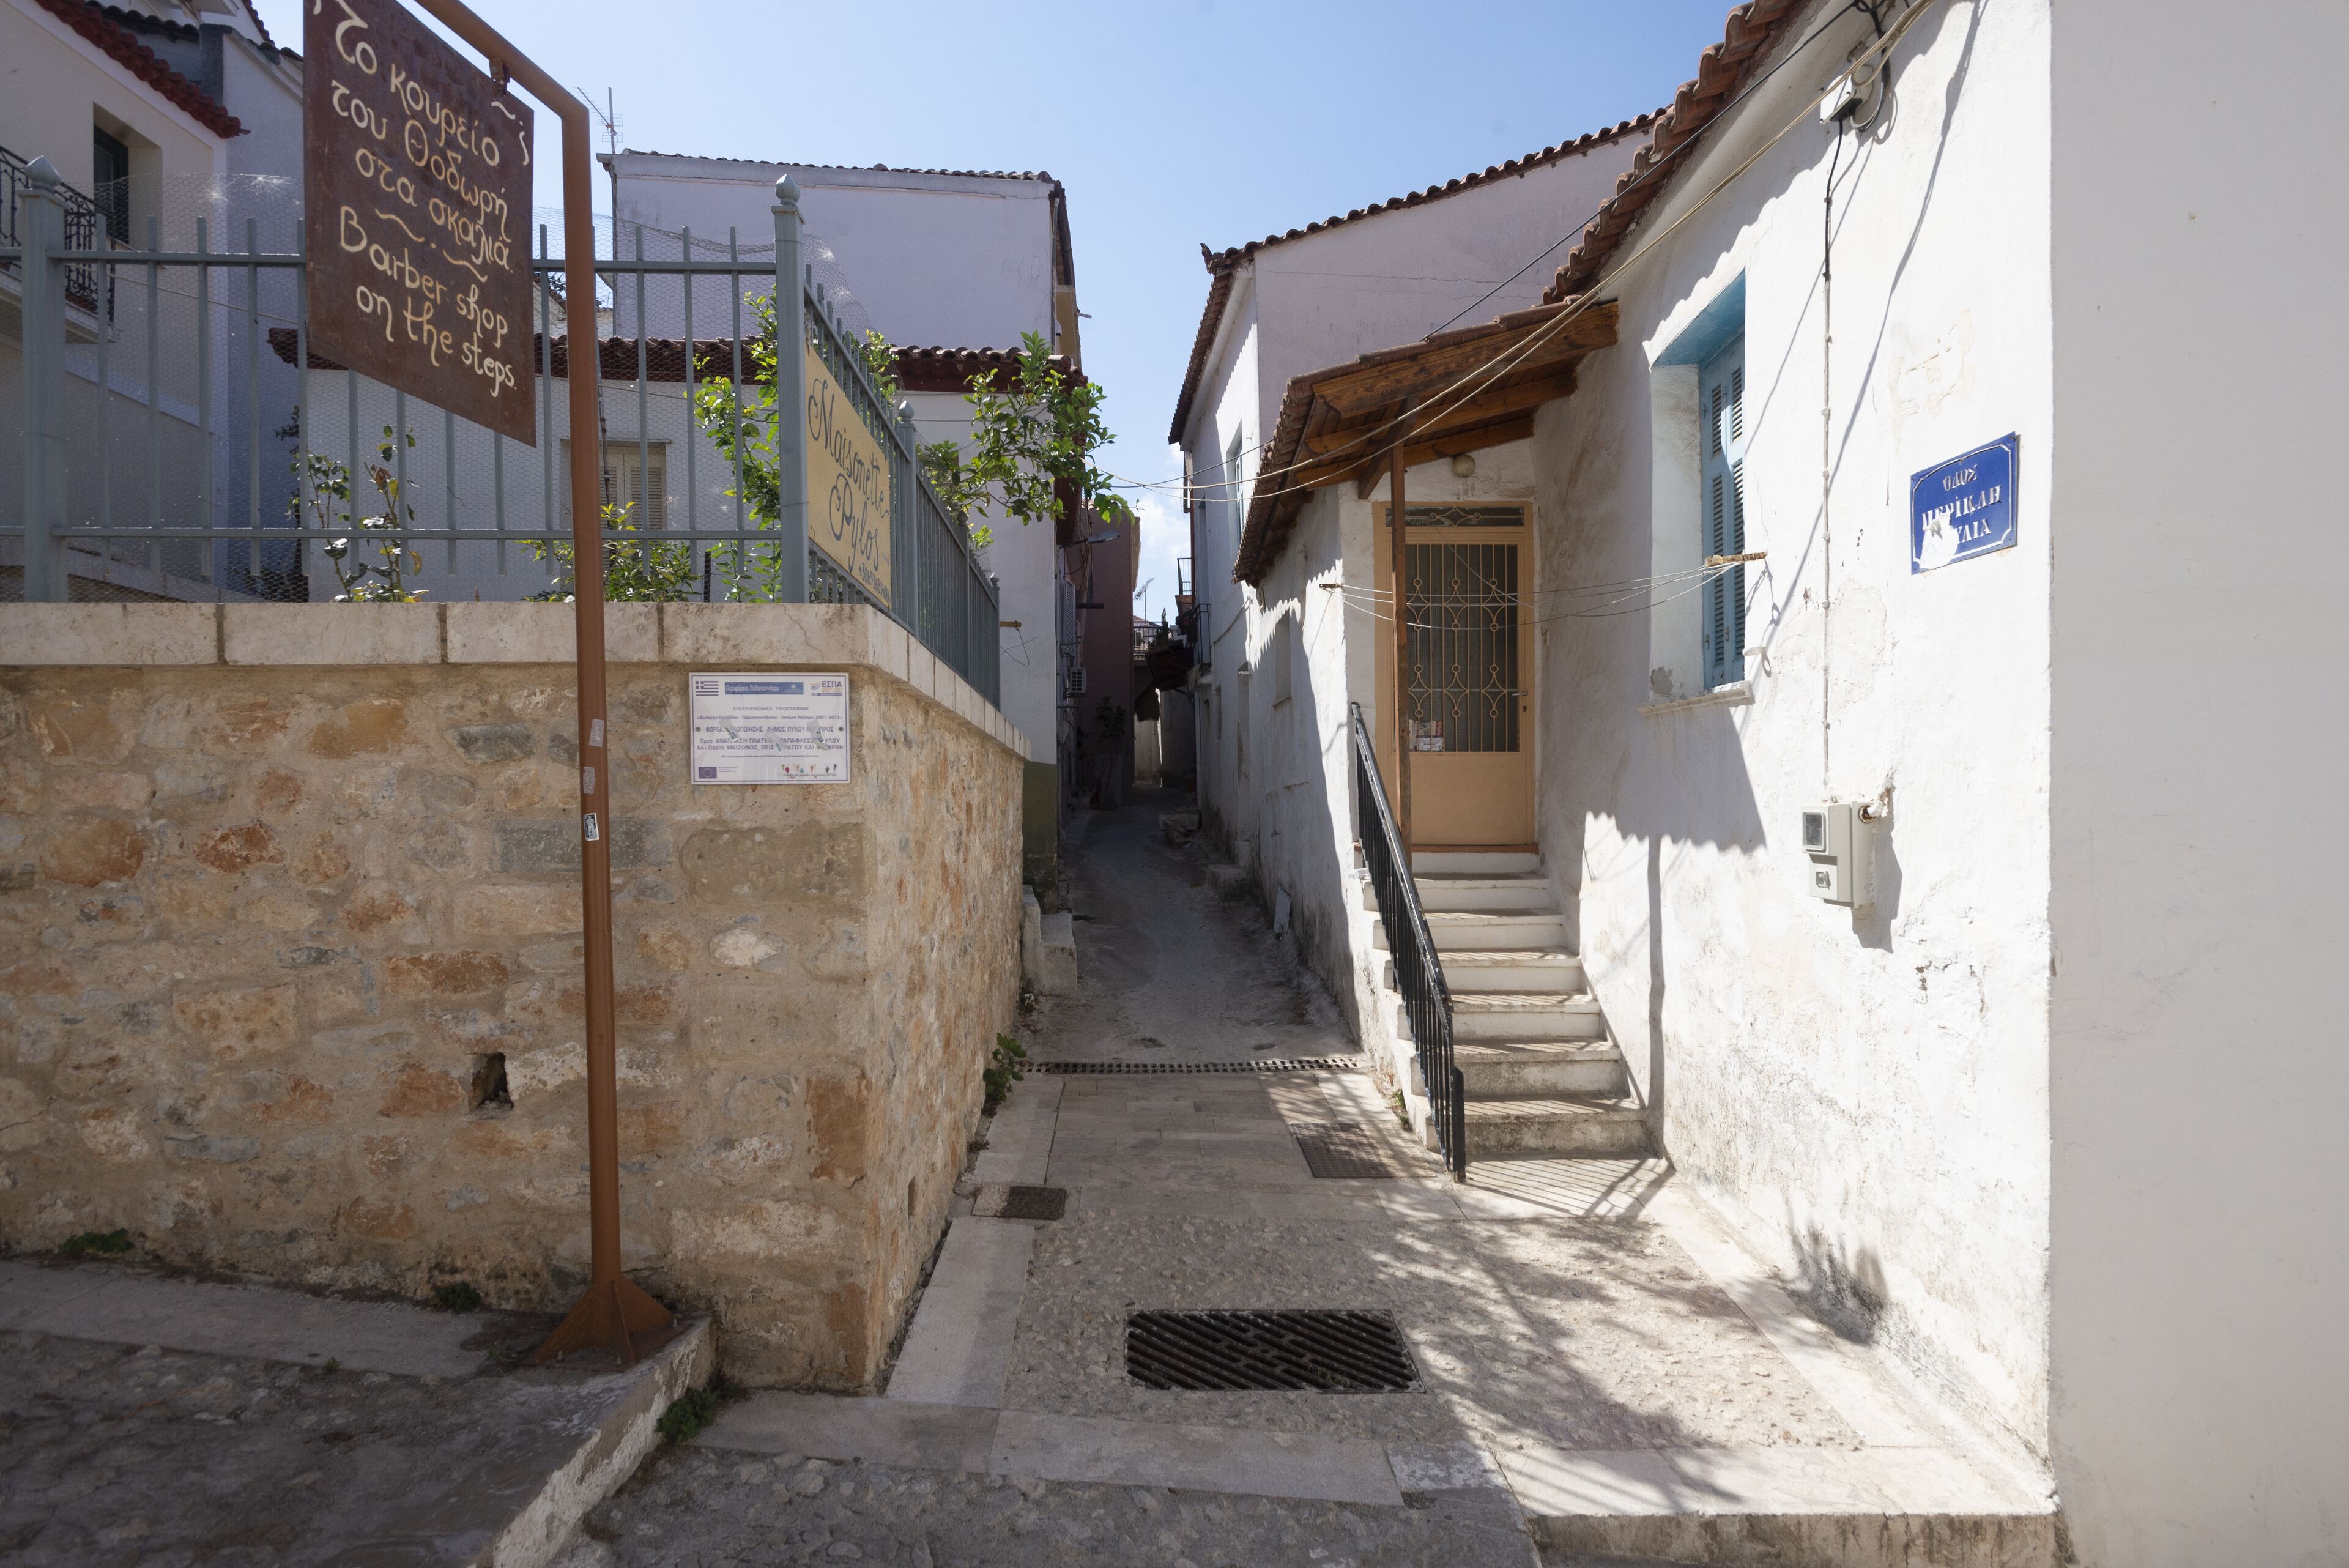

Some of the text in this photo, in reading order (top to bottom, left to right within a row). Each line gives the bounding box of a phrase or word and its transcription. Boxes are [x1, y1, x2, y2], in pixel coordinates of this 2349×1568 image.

[332, 80, 388, 140] του
[355, 147, 417, 207] στα
[341, 206, 508, 349] Barber shop
[357, 286, 394, 342] on
[403, 296, 453, 367] the
[808, 377, 889, 519] Maisonette
[1943, 464, 1978, 492] ΟΔΟΣ
[829, 472, 879, 574] Pylos
